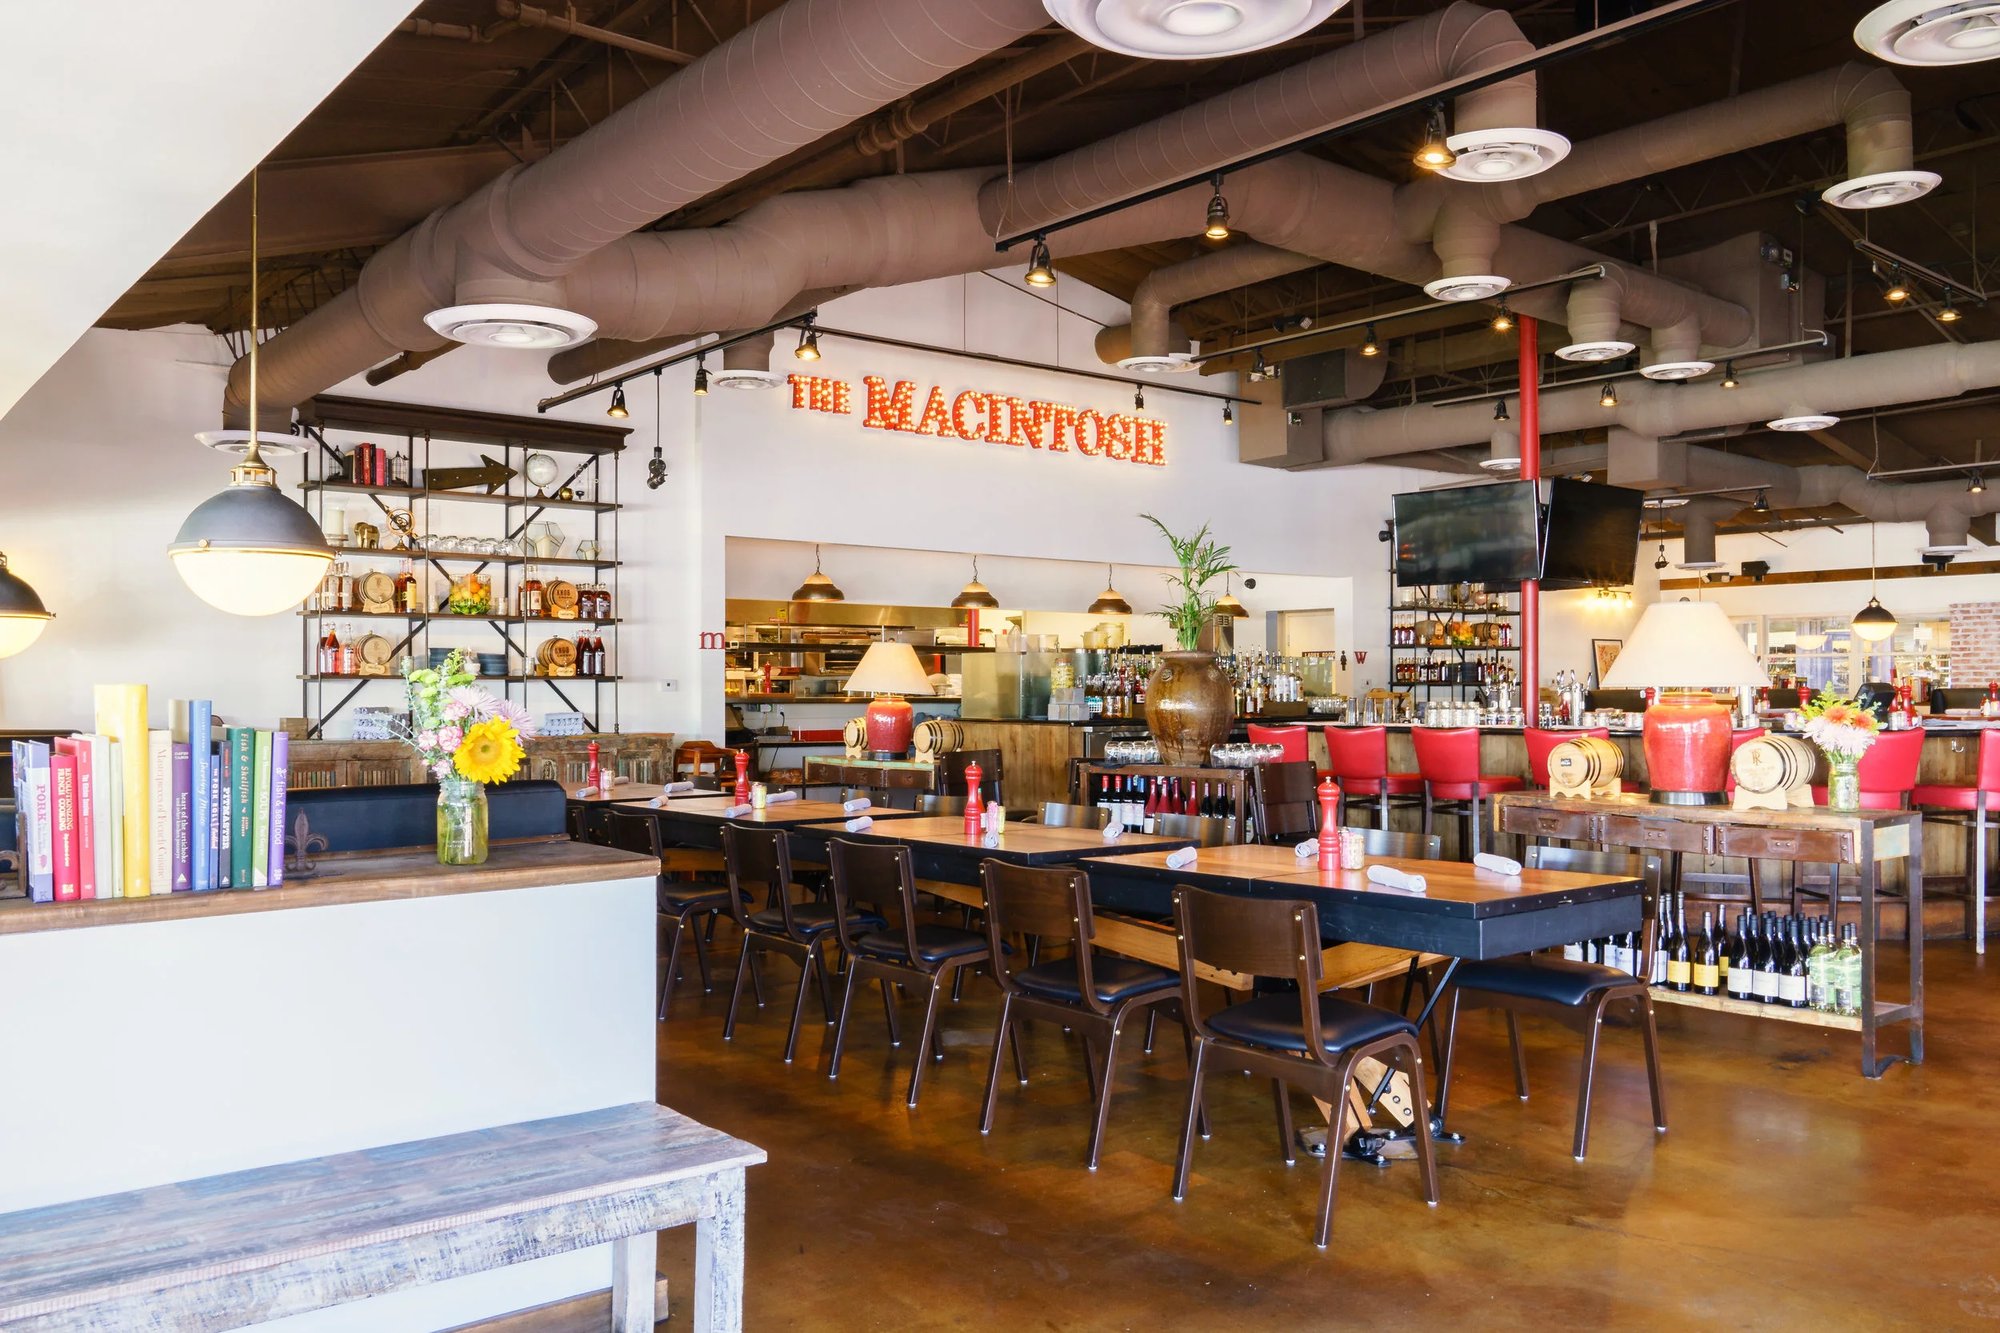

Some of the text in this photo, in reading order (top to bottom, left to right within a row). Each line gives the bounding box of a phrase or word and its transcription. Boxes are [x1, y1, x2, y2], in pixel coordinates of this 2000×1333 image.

[787, 374, 1168, 466] THE MACINTOSH
[240, 733, 249, 751] Fish
[57, 768, 65, 795] FRENCH
[156, 749, 166, 802] Masterpieces
[239, 765, 249, 804] Shellfish
[36, 784, 47, 822] PORK
[58, 798, 67, 832] COOKING
[65, 767, 73, 831] REVOLUTIONIZING
[180, 792, 188, 811] heart
[274, 781, 286, 845] fish & seafood
[157, 814, 167, 846] French
[222, 787, 231, 850] PITMASTER
[157, 847, 168, 879] Cuisine
[180, 832, 188, 863] artichoke
